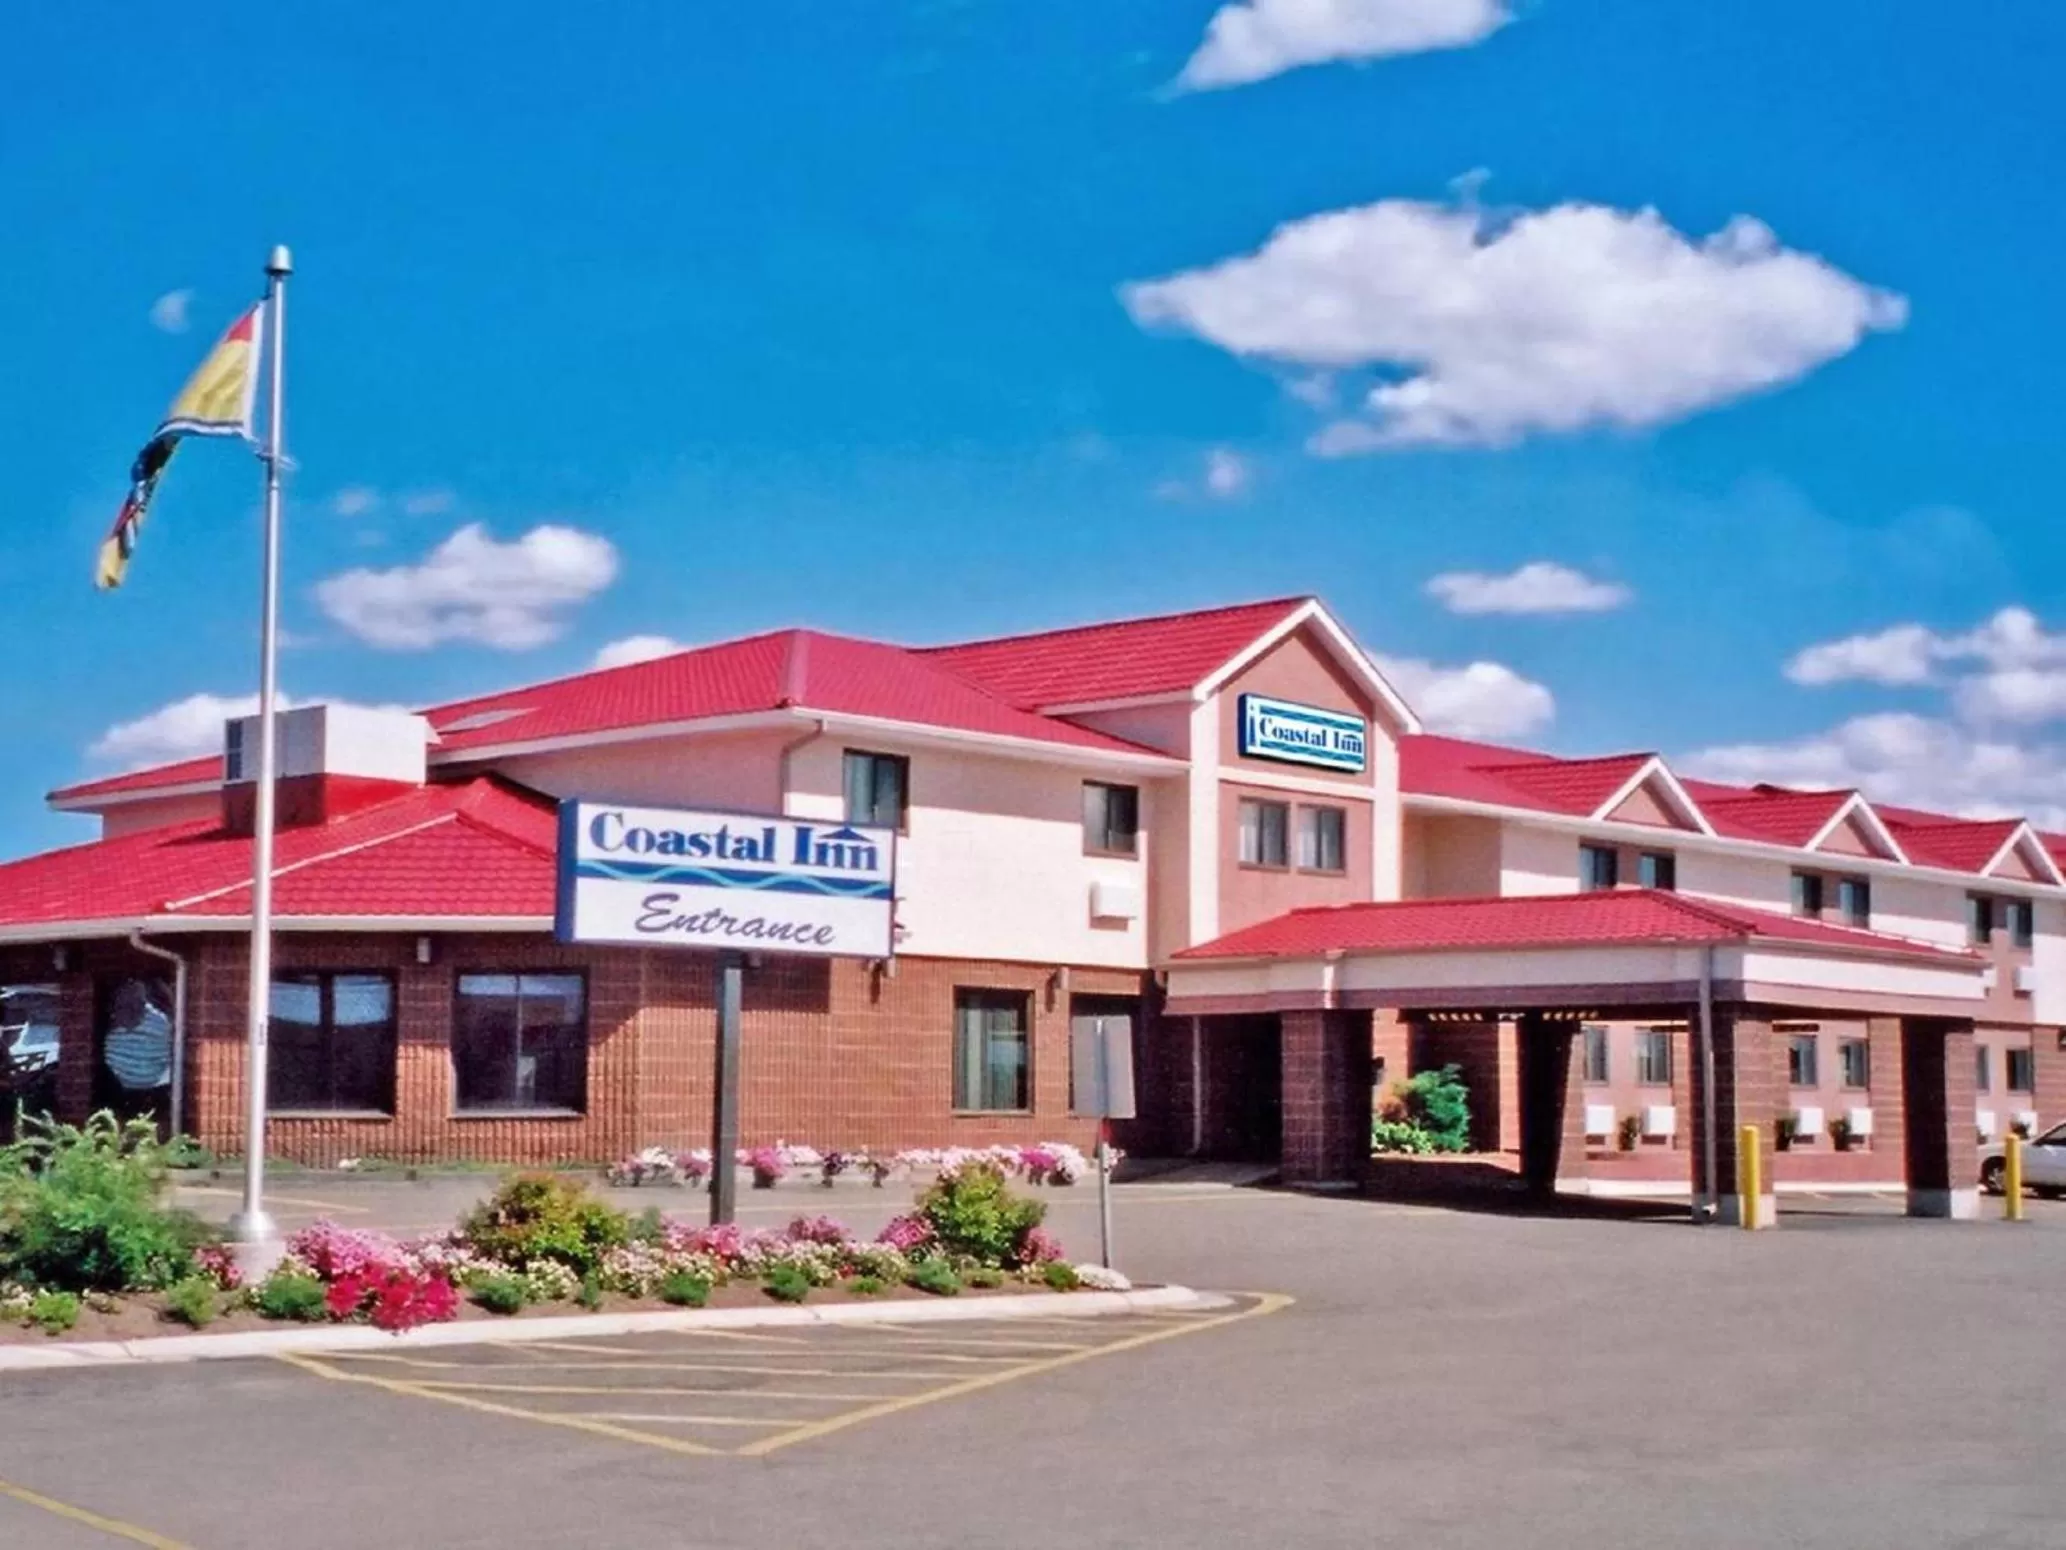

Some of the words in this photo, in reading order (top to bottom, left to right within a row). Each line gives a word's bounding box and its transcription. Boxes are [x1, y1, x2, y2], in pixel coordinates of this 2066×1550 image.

[1259, 717, 1327, 747] Coastal
[1333, 731, 1362, 753] Inn
[589, 811, 777, 864] Coastal
[789, 825, 878, 871] Inn
[634, 892, 837, 946] Entrance
